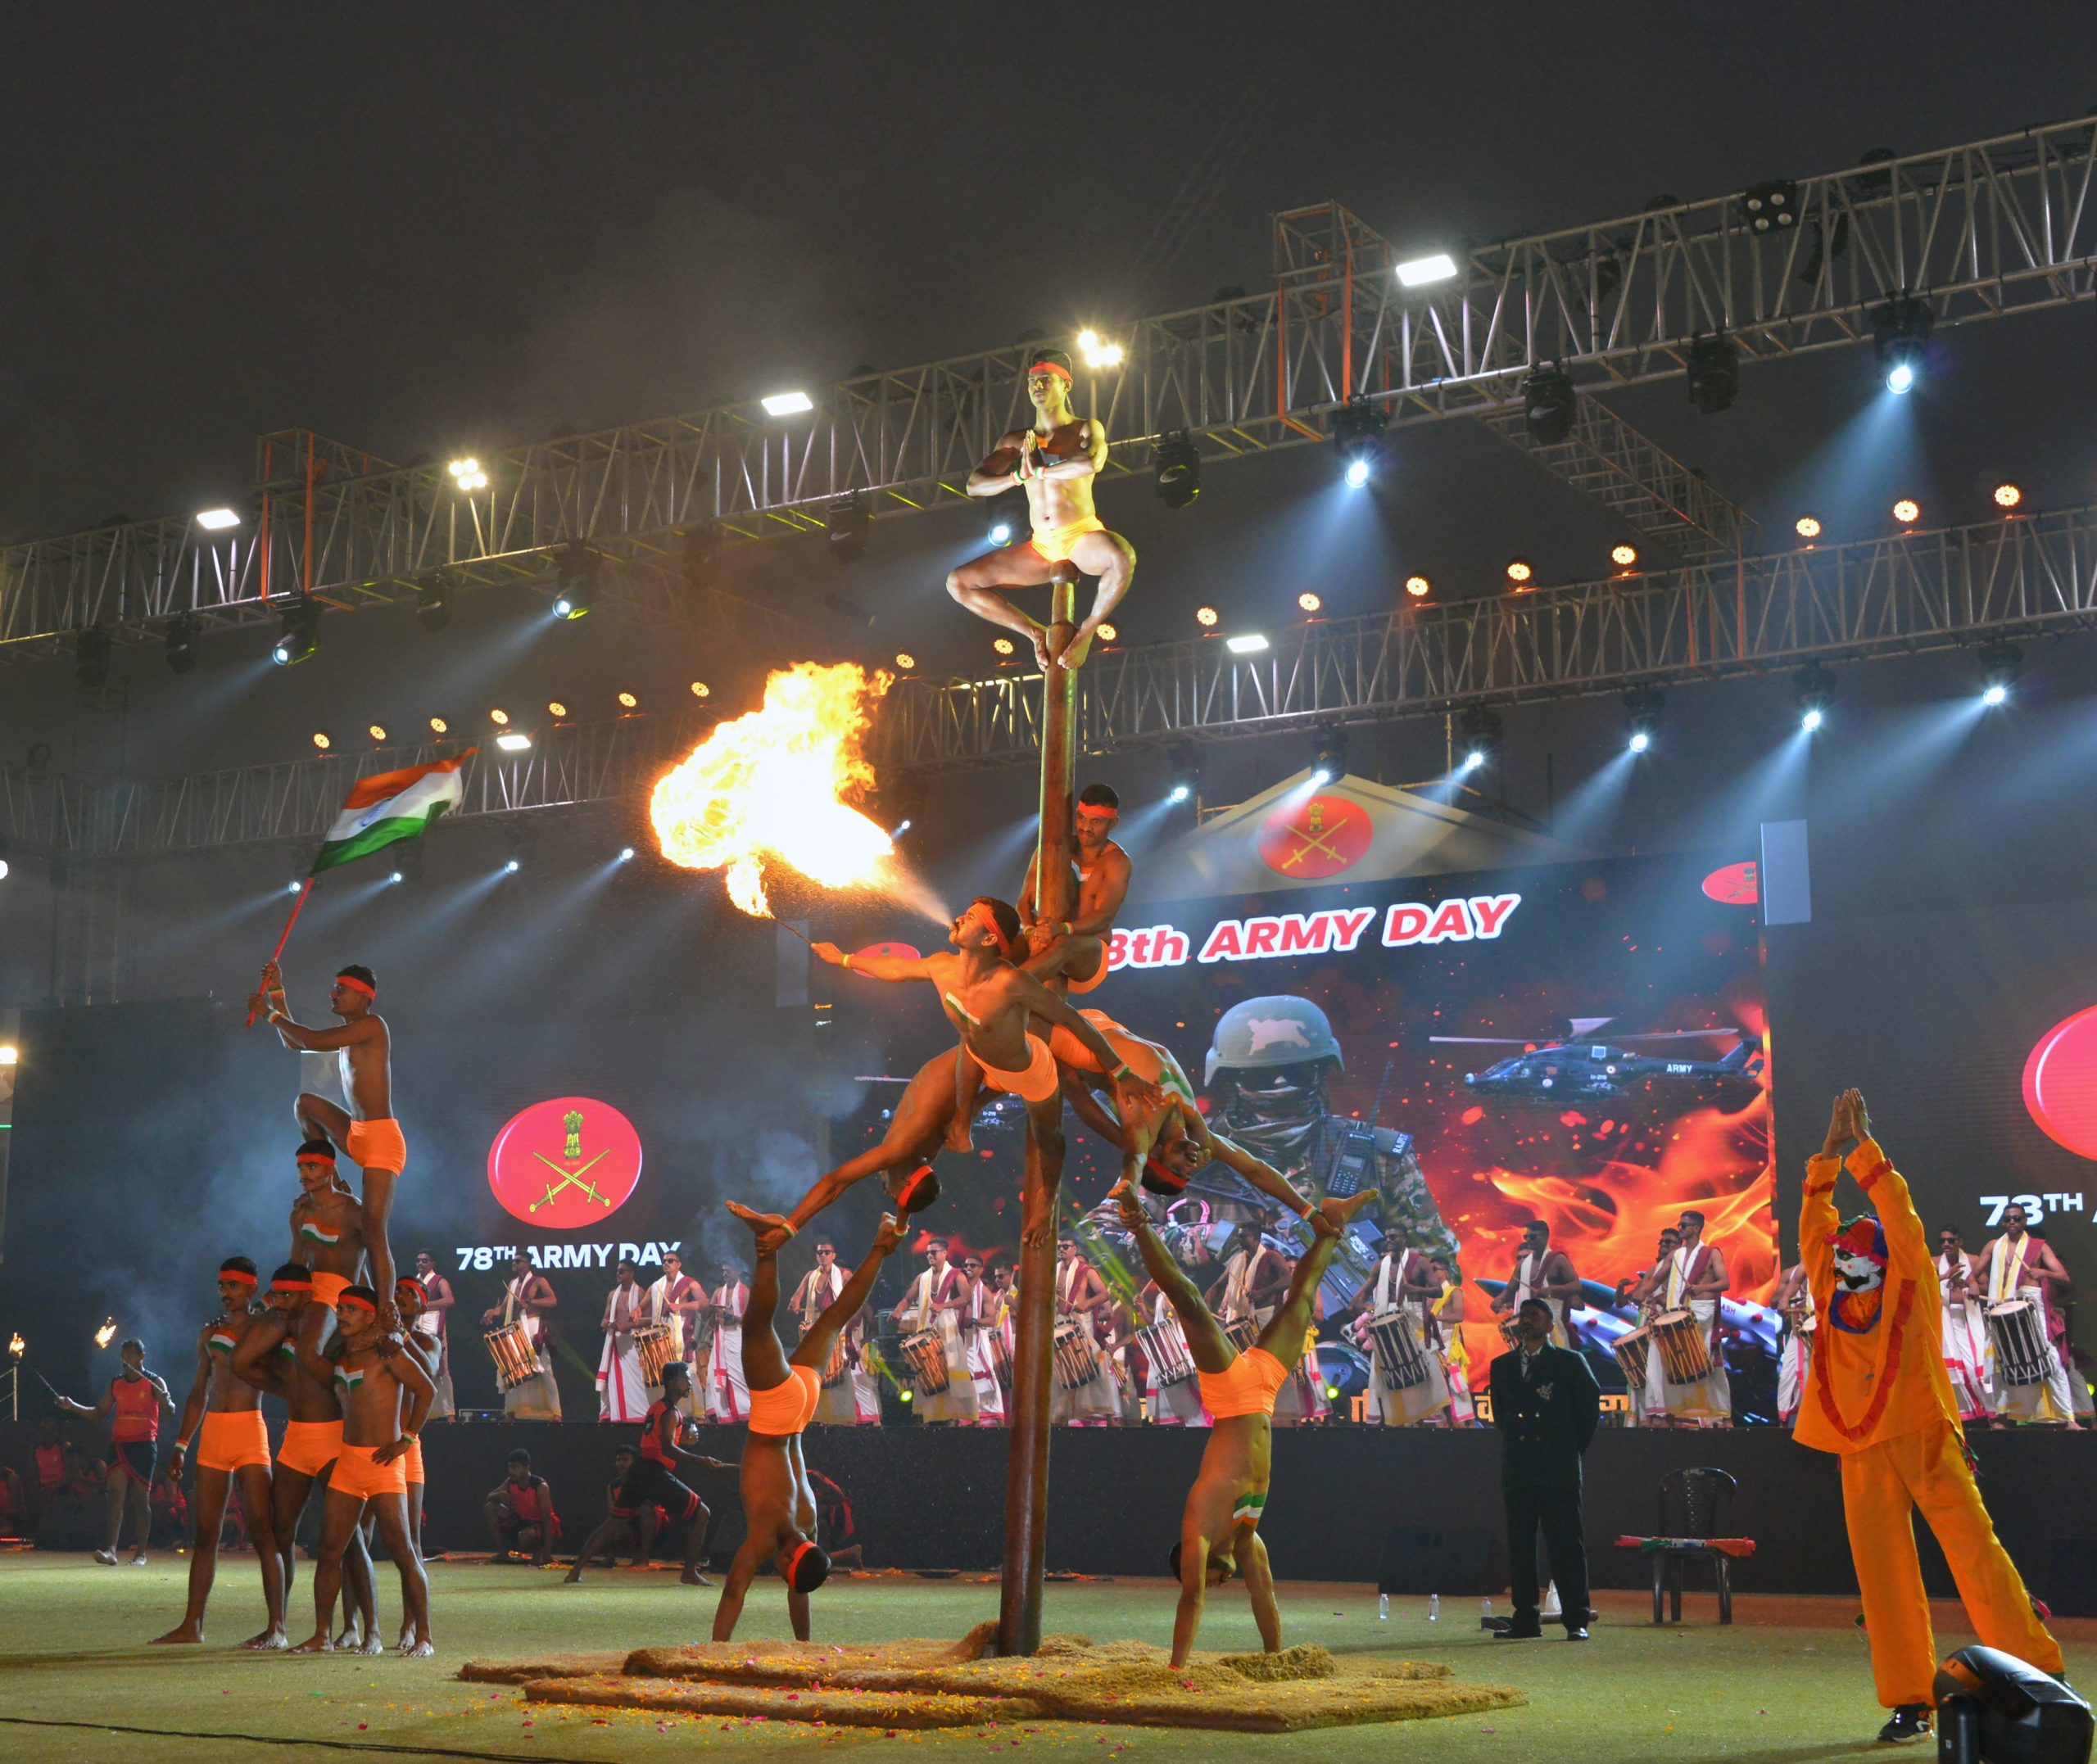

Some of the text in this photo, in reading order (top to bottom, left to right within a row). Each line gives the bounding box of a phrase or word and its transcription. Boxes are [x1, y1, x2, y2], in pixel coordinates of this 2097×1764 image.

[1199, 907, 1376, 962] ARMY
[1383, 894, 1520, 946] DAY
[1666, 1064, 1692, 1073] ARMY
[456, 1246, 516, 1271] 78TH
[526, 1244, 614, 1269] ARMY
